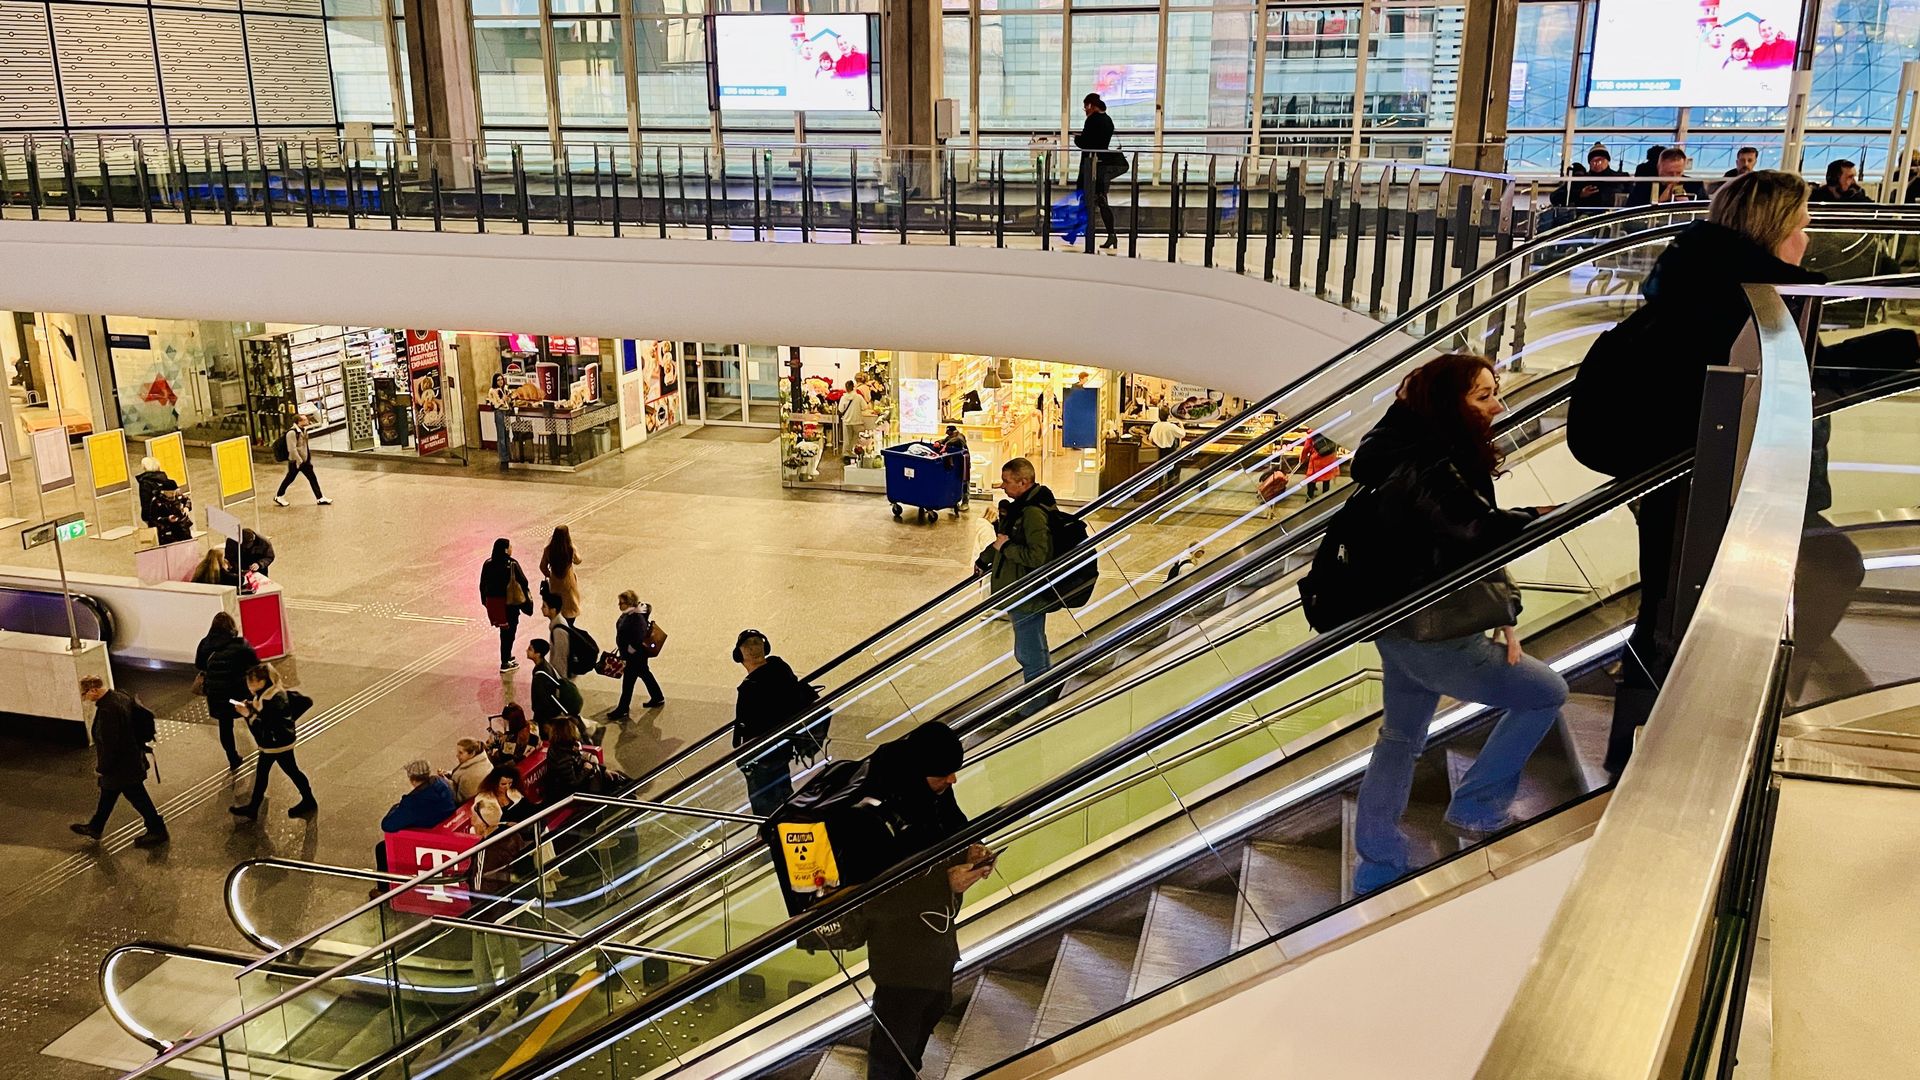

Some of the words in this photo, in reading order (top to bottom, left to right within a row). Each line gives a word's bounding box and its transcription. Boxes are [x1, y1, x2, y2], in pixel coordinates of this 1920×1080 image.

[408, 340, 437, 356] PIEROGI
[544, 372, 552, 394] COSTA
[787, 833, 814, 843] CAUTION
[415, 847, 459, 903] T
